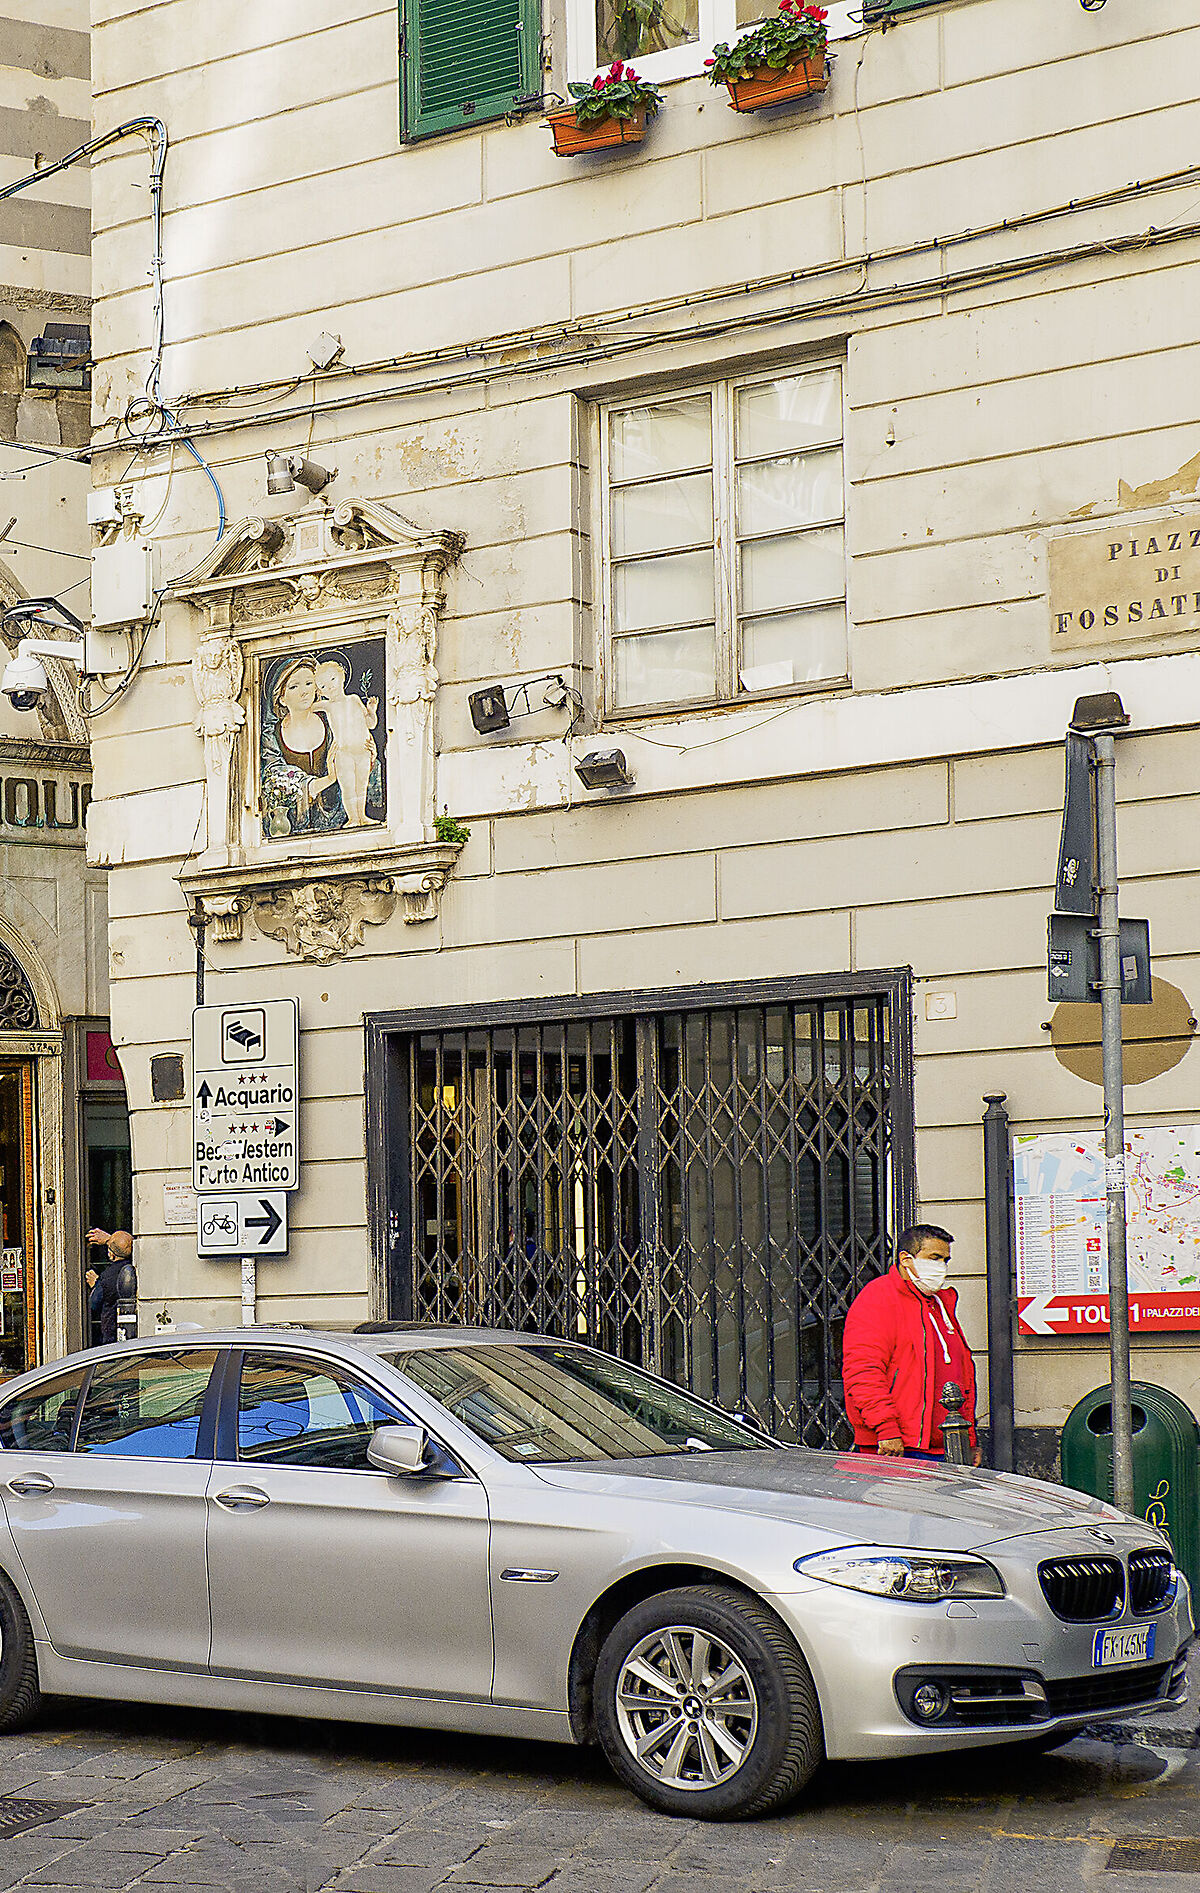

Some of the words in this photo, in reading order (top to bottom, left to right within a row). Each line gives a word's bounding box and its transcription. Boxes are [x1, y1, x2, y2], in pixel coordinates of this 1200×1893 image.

[1154, 565, 1181, 583] DI
[214, 1083, 293, 1108] Acquario
[197, 1141, 227, 1160] Bes
[242, 1162, 289, 1182] Antico
[1072, 1305, 1110, 1324] TOU
[1129, 1302, 1139, 1323] 1
[1147, 1307, 1183, 1318] PALAZZI
